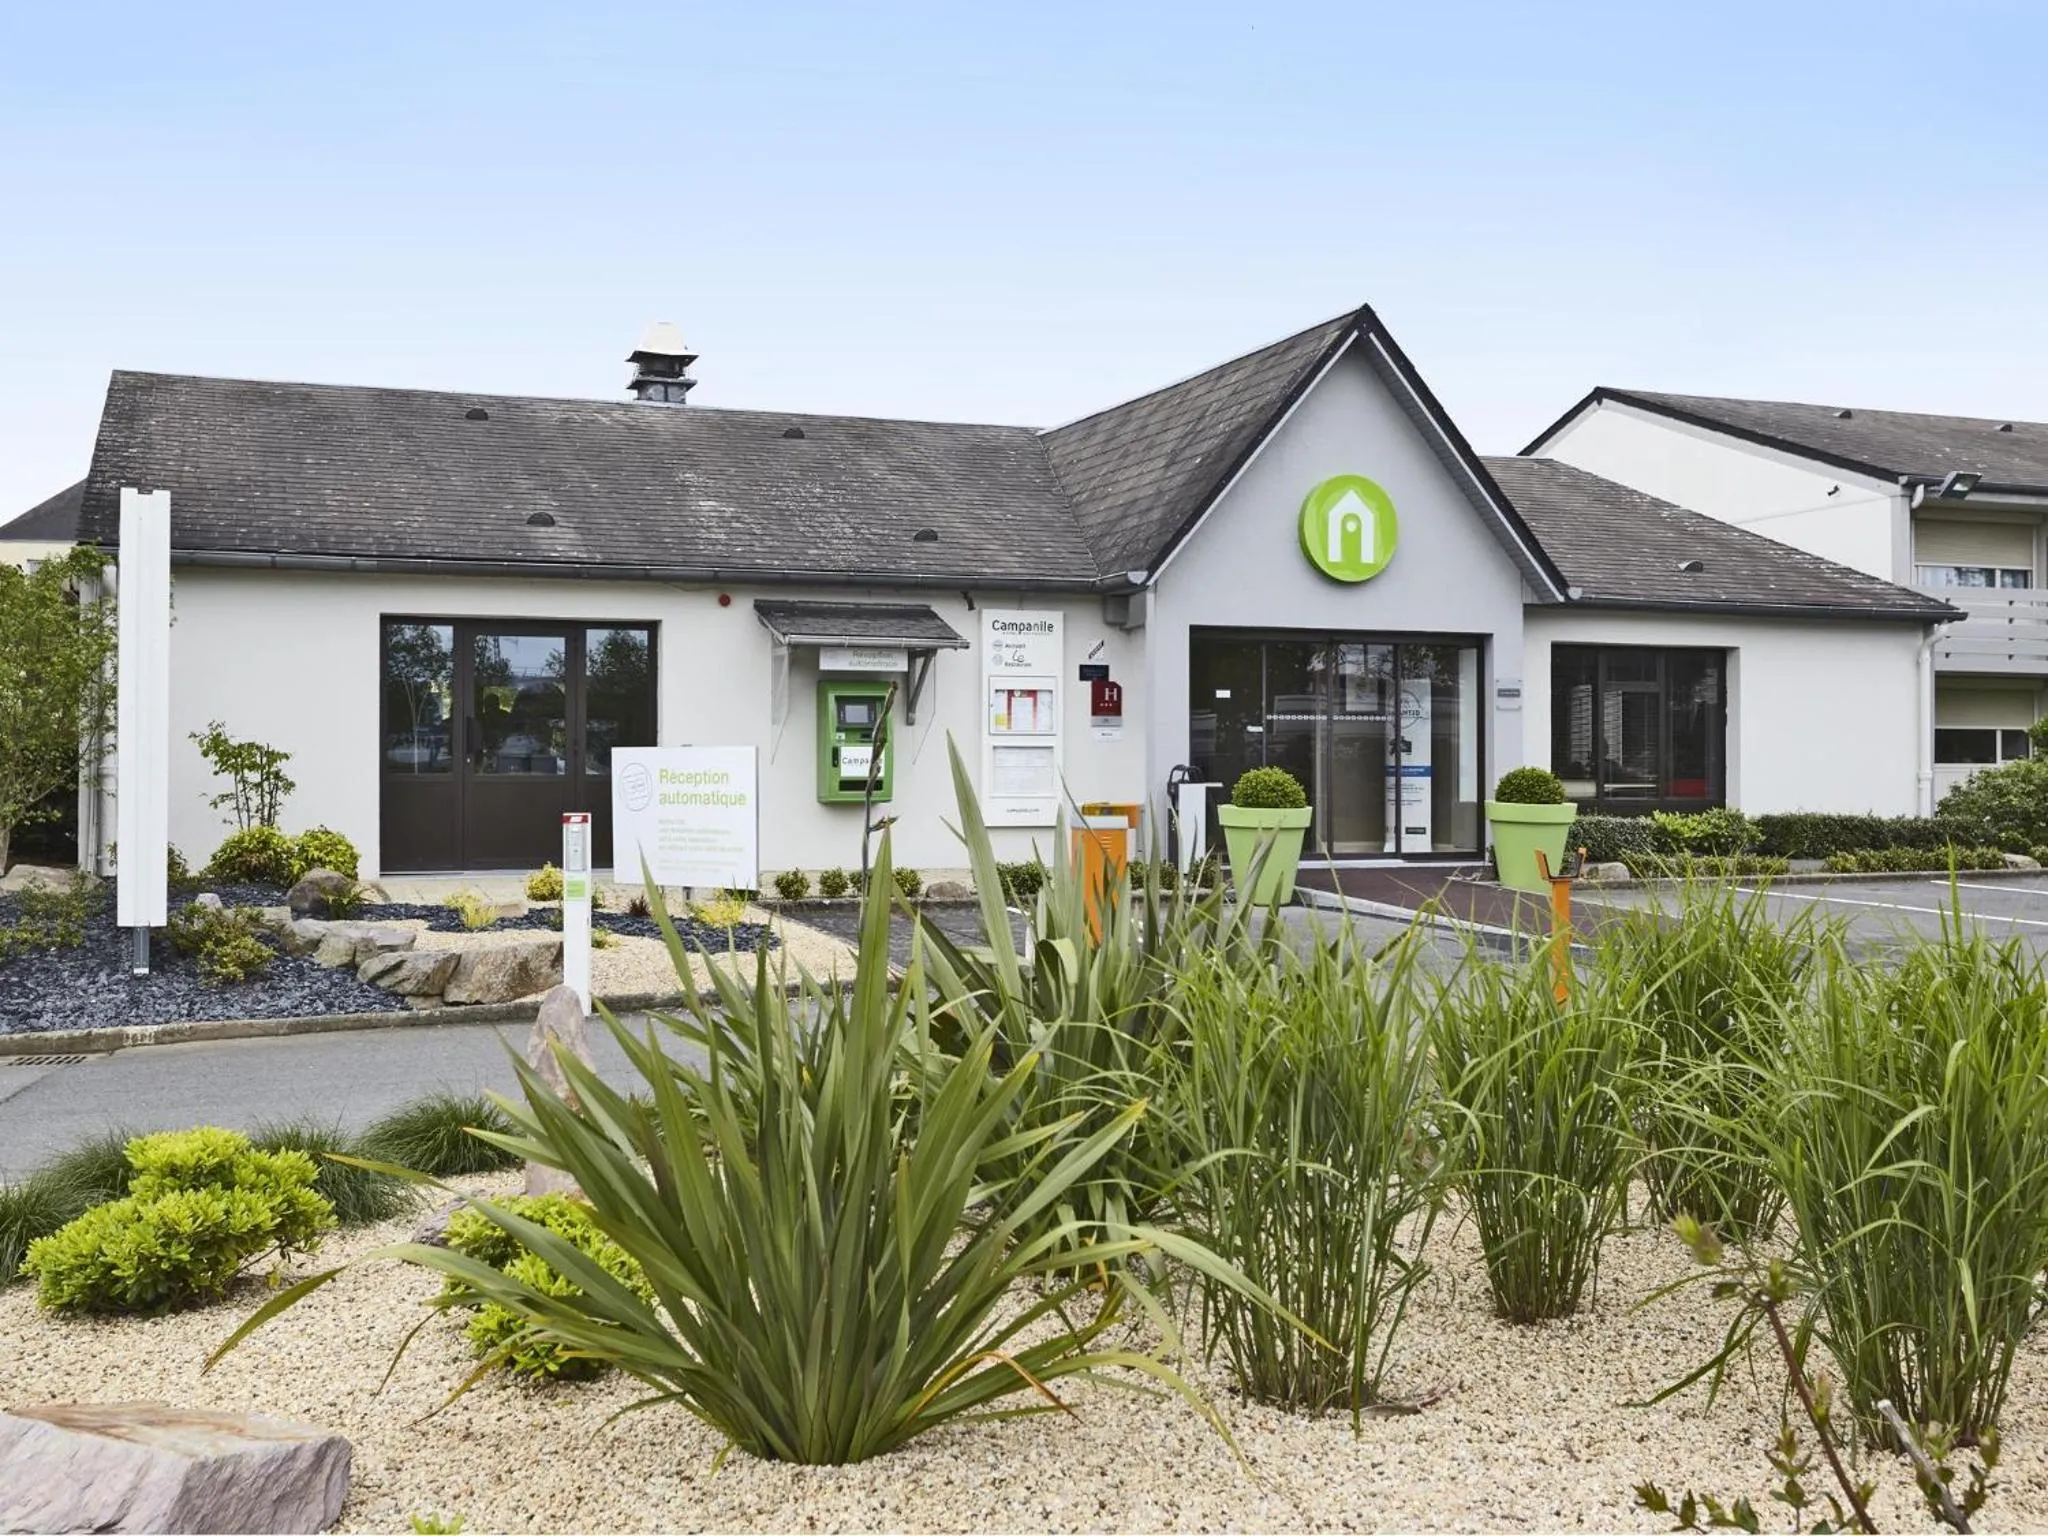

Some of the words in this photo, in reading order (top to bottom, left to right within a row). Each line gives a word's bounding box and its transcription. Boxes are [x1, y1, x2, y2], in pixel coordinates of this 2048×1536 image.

[992, 619, 1055, 635] Campanile
[1104, 687, 1118, 701] H
[659, 790, 747, 808] automatique
